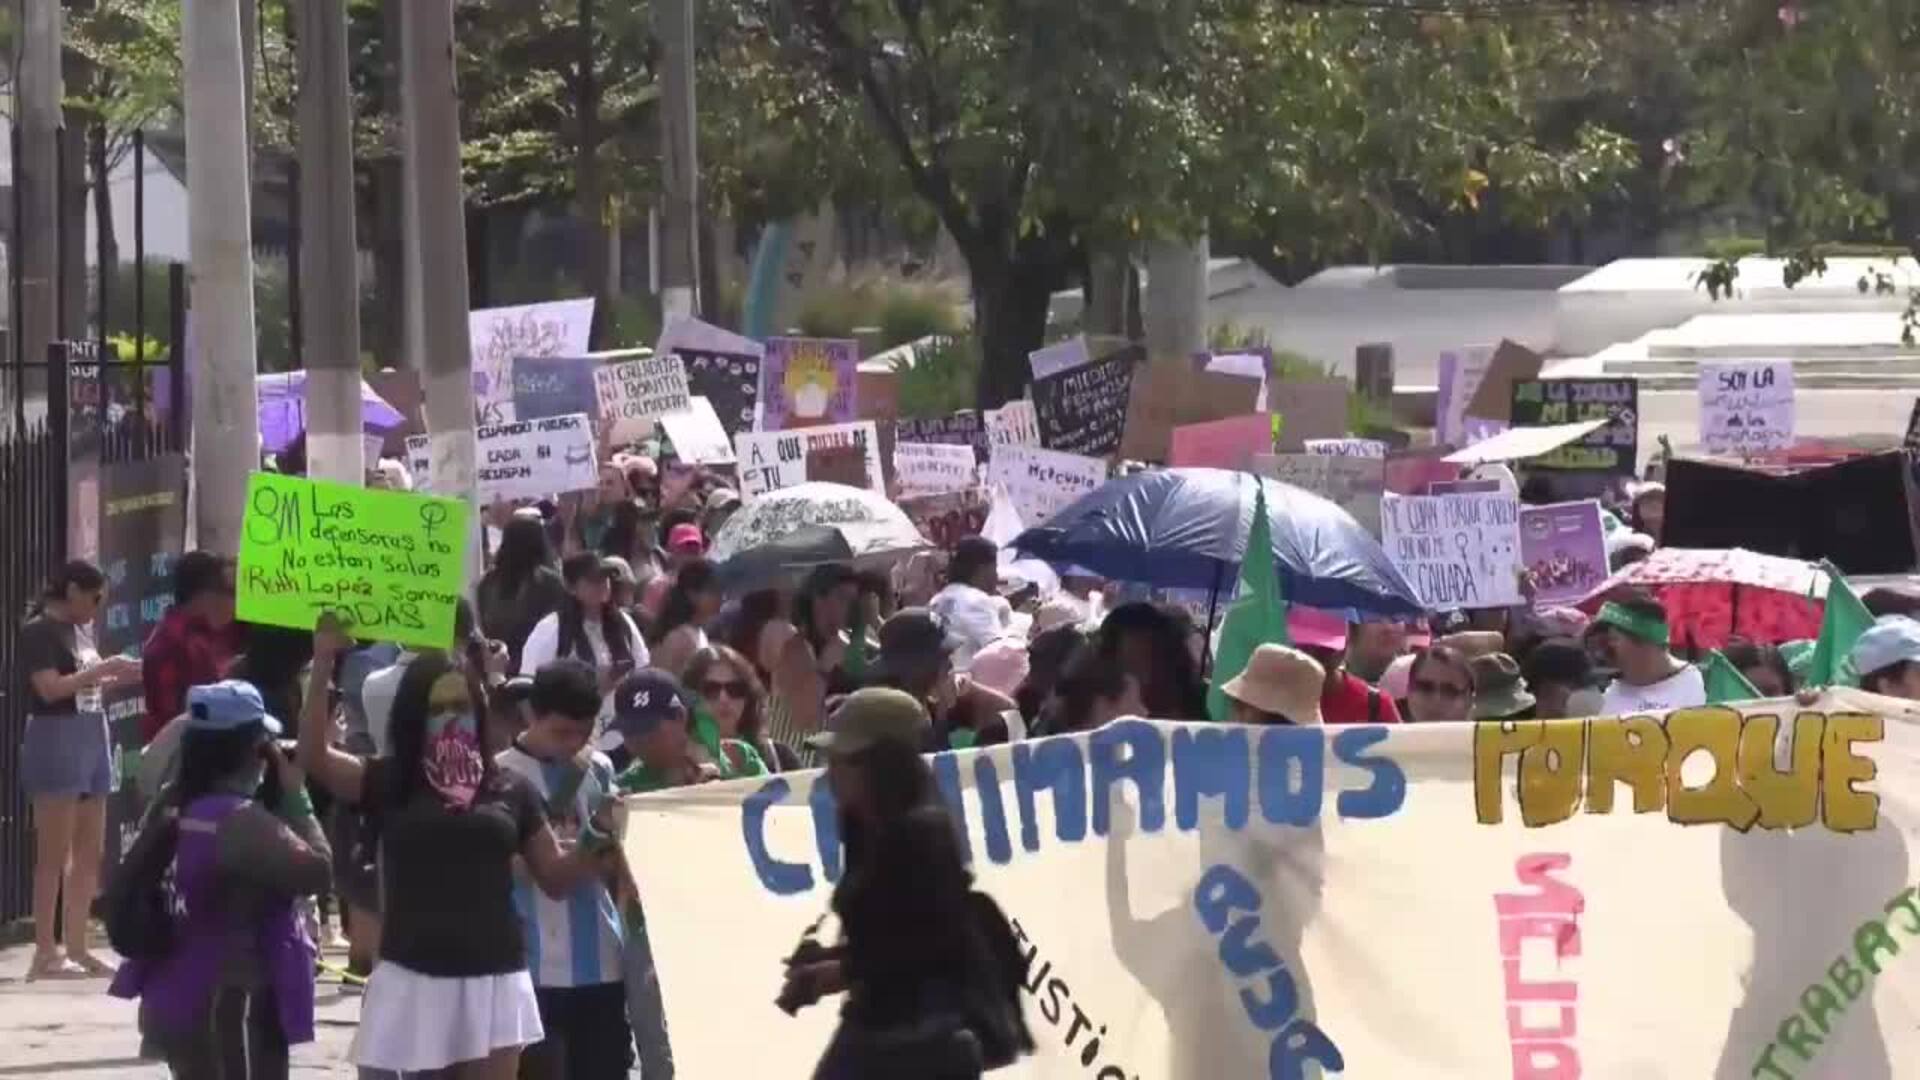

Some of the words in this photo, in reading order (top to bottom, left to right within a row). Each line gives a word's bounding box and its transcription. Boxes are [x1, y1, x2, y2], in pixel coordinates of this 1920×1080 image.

[752, 442, 764, 466] A
[282, 549, 307, 570] No
[1472, 707, 1885, 834] PORQUE
